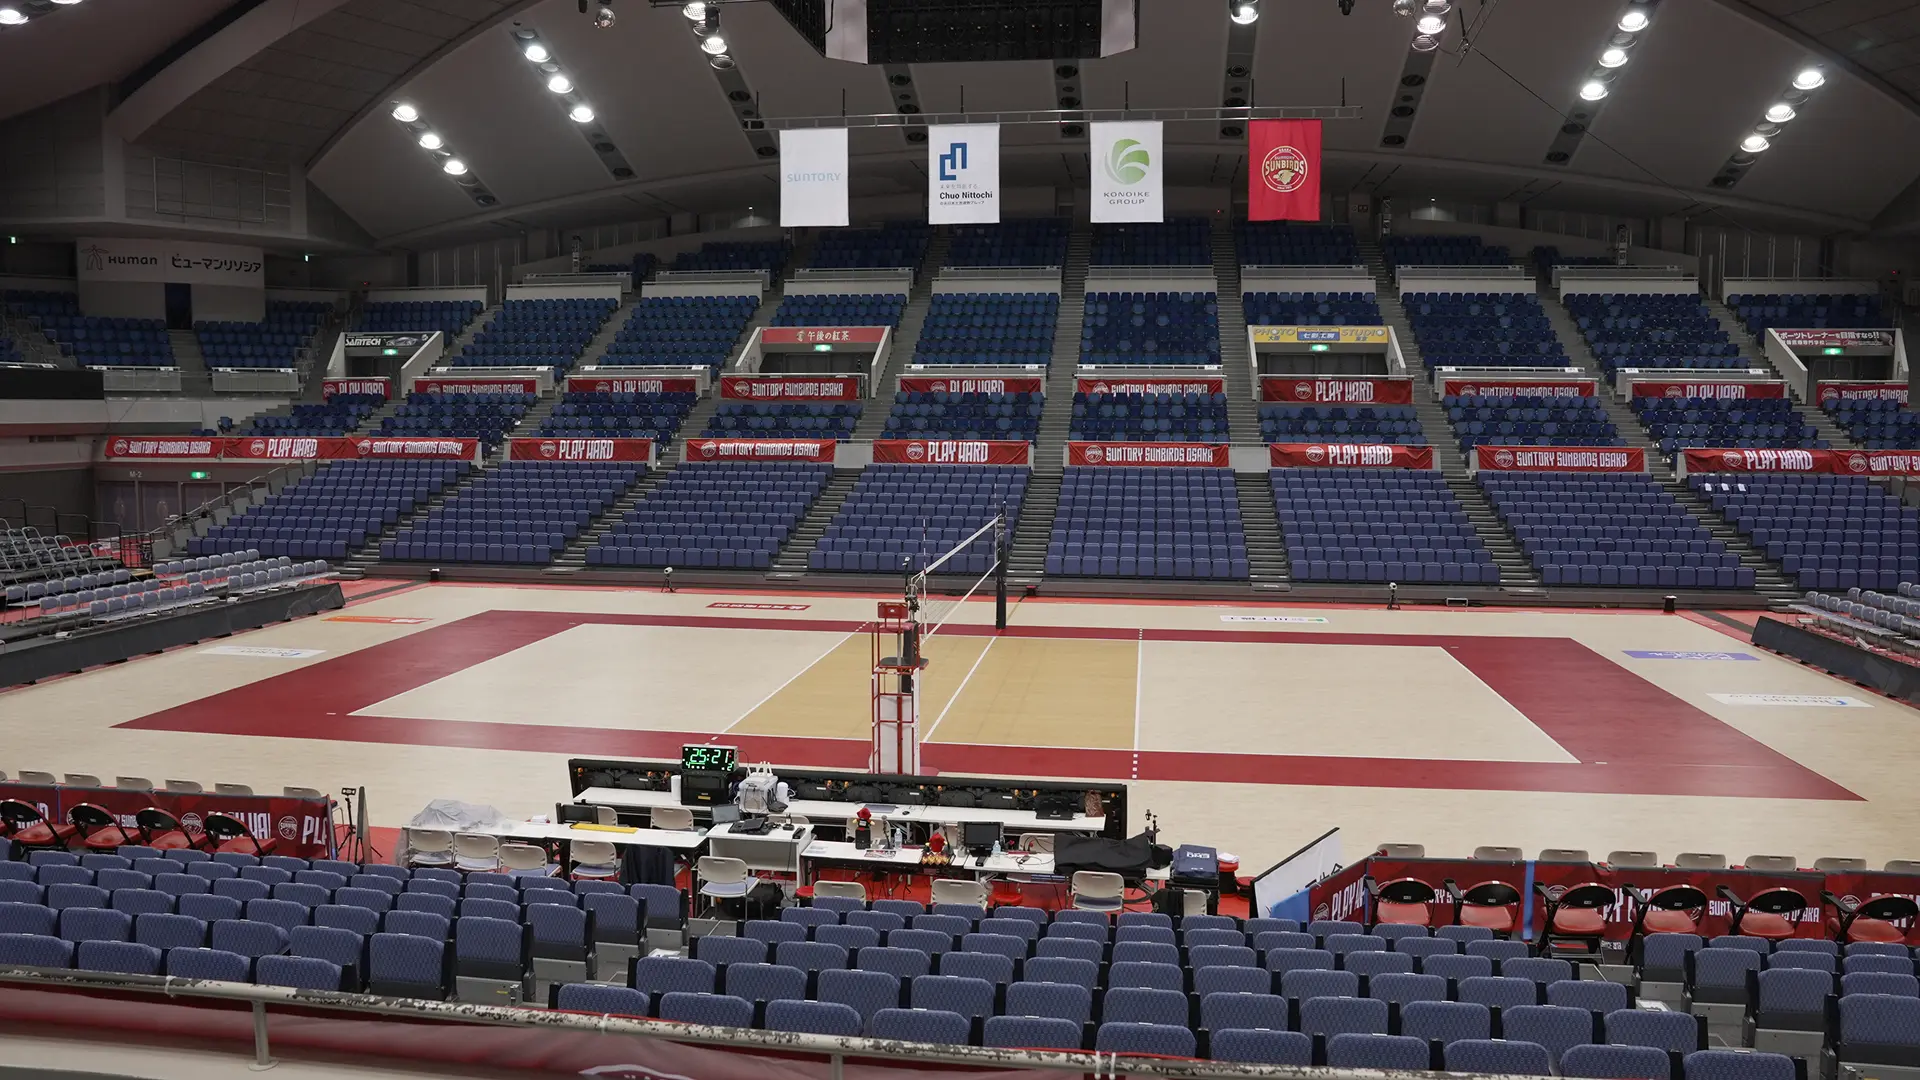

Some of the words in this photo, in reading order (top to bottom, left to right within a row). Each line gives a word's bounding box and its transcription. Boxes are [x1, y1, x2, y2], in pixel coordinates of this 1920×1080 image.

[1264, 159, 1305, 176] SUNBIRDS
[787, 172, 841, 183] SUNTORY
[939, 191, 960, 200] Chuo
[961, 190, 993, 199] Nittochi
[108, 255, 158, 265] Human
[807, 330, 850, 342] 午後の紅茶
[1253, 327, 1296, 337] PHOTO
[1341, 327, 1386, 337] STUDIO
[752, 382, 783, 396] SUNTORY
[784, 382, 819, 396] SUNBIRDS
[820, 382, 844, 396] OSAKA
[1315, 381, 1343, 402] PLAY
[1345, 381, 1374, 402] HARD
[128, 439, 159, 454] SUNTORY
[158, 440, 189, 455] SUNBIRDS
[189, 441, 211, 455] OSAKA
[267, 438, 291, 458] PLAY
[291, 438, 318, 458] HARD
[558, 439, 585, 460] PLAY
[586, 439, 614, 460] HARD
[719, 442, 754, 456] SUNTORY
[755, 442, 793, 456] SUNBIRDS
[793, 443, 821, 457] OSAKA
[928, 441, 956, 462] PLAY
[958, 441, 989, 462] HARD
[1105, 446, 1143, 462] SUNTORY
[1144, 446, 1185, 463] SUNBIRDS
[1186, 447, 1213, 463] OSAKA
[1327, 445, 1358, 465] PLAY
[1360, 445, 1393, 465] HARD
[1516, 451, 1555, 467] SUNTORY
[1556, 452, 1598, 468] SUNBIRDS
[1599, 452, 1628, 468] OSAKA
[1743, 450, 1777, 471] PLAY
[1778, 450, 1813, 471] HARD
[1869, 455, 1911, 473] SUNTORY
